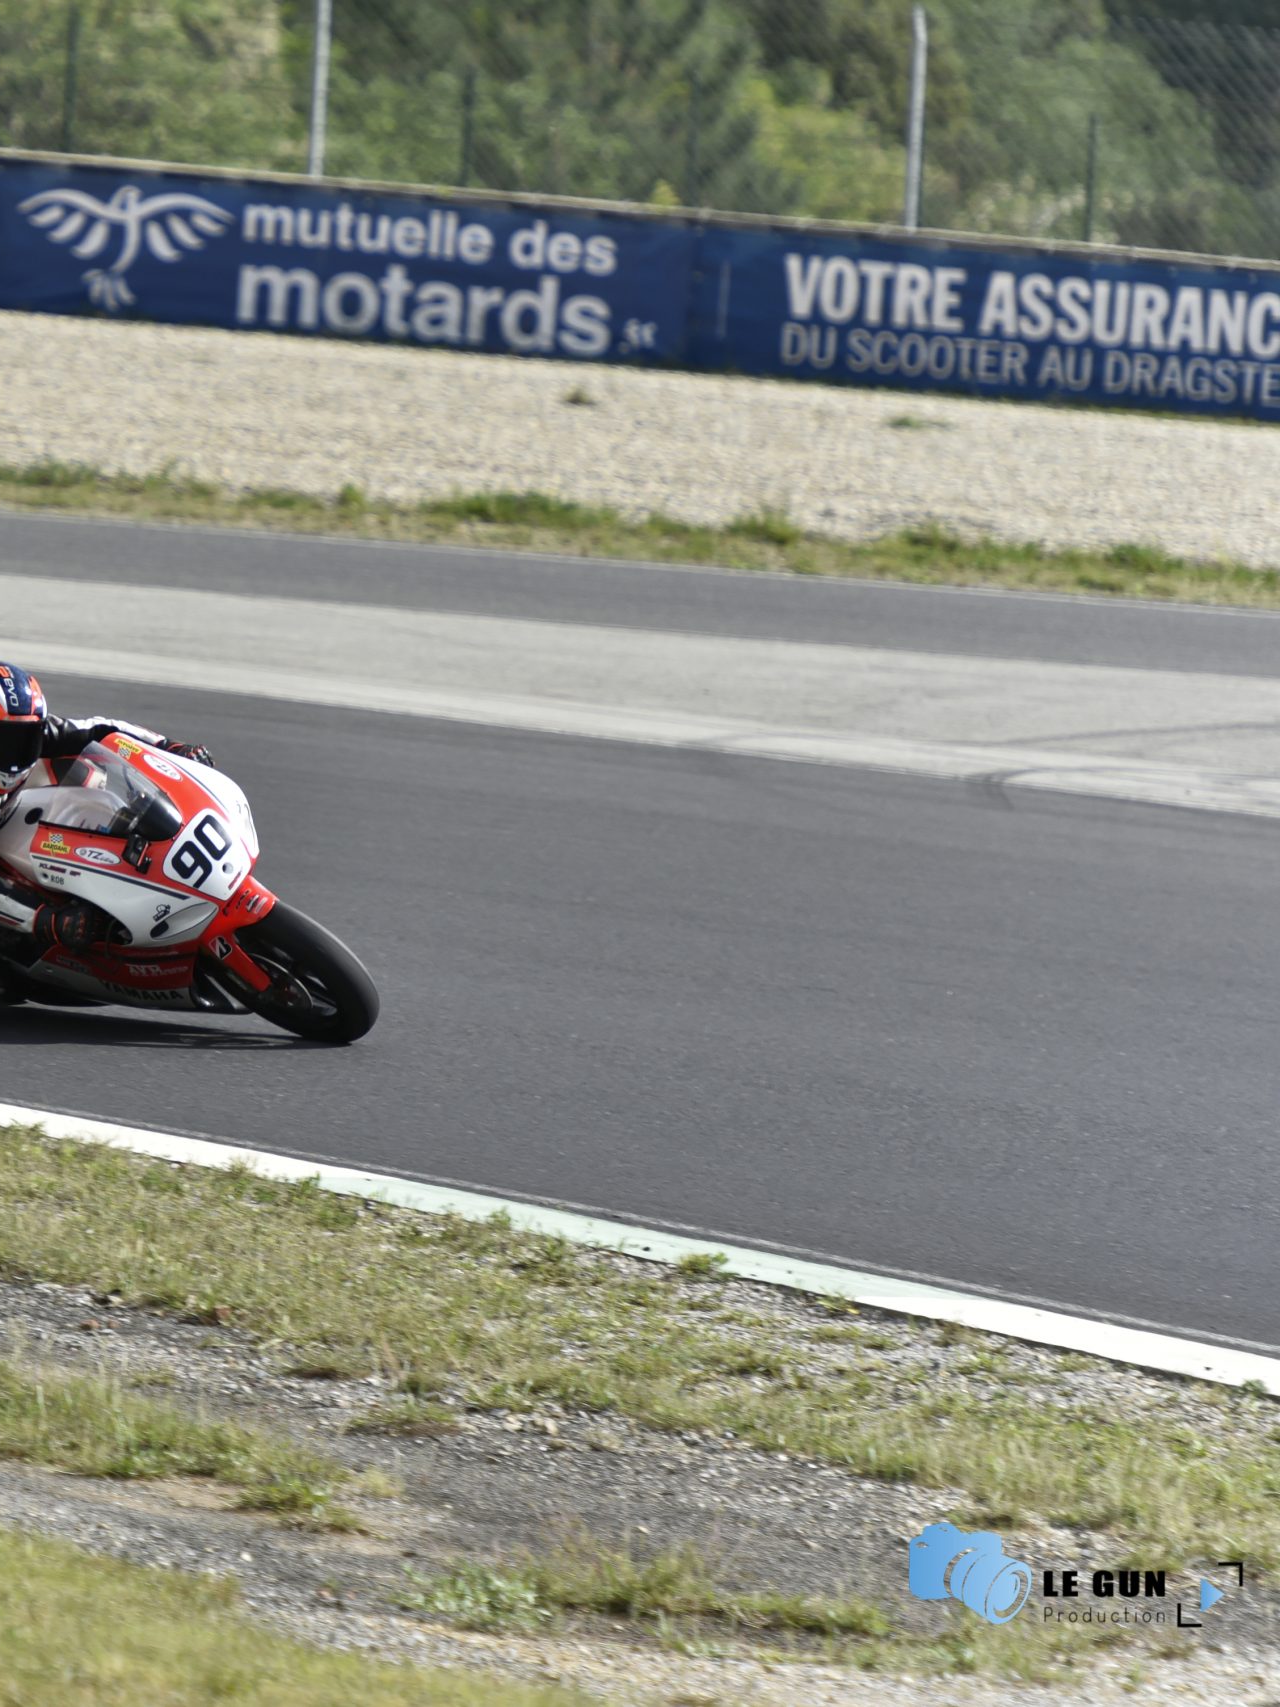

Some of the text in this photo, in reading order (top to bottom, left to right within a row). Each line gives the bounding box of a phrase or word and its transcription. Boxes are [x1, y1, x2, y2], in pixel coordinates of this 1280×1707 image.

[242, 203, 619, 277] mutuelle des
[784, 252, 1280, 361] VOTRE ASSURANC
[779, 322, 1280, 408] DU SCOOTER AU DRAGSTE
[171, 814, 233, 889] 90
